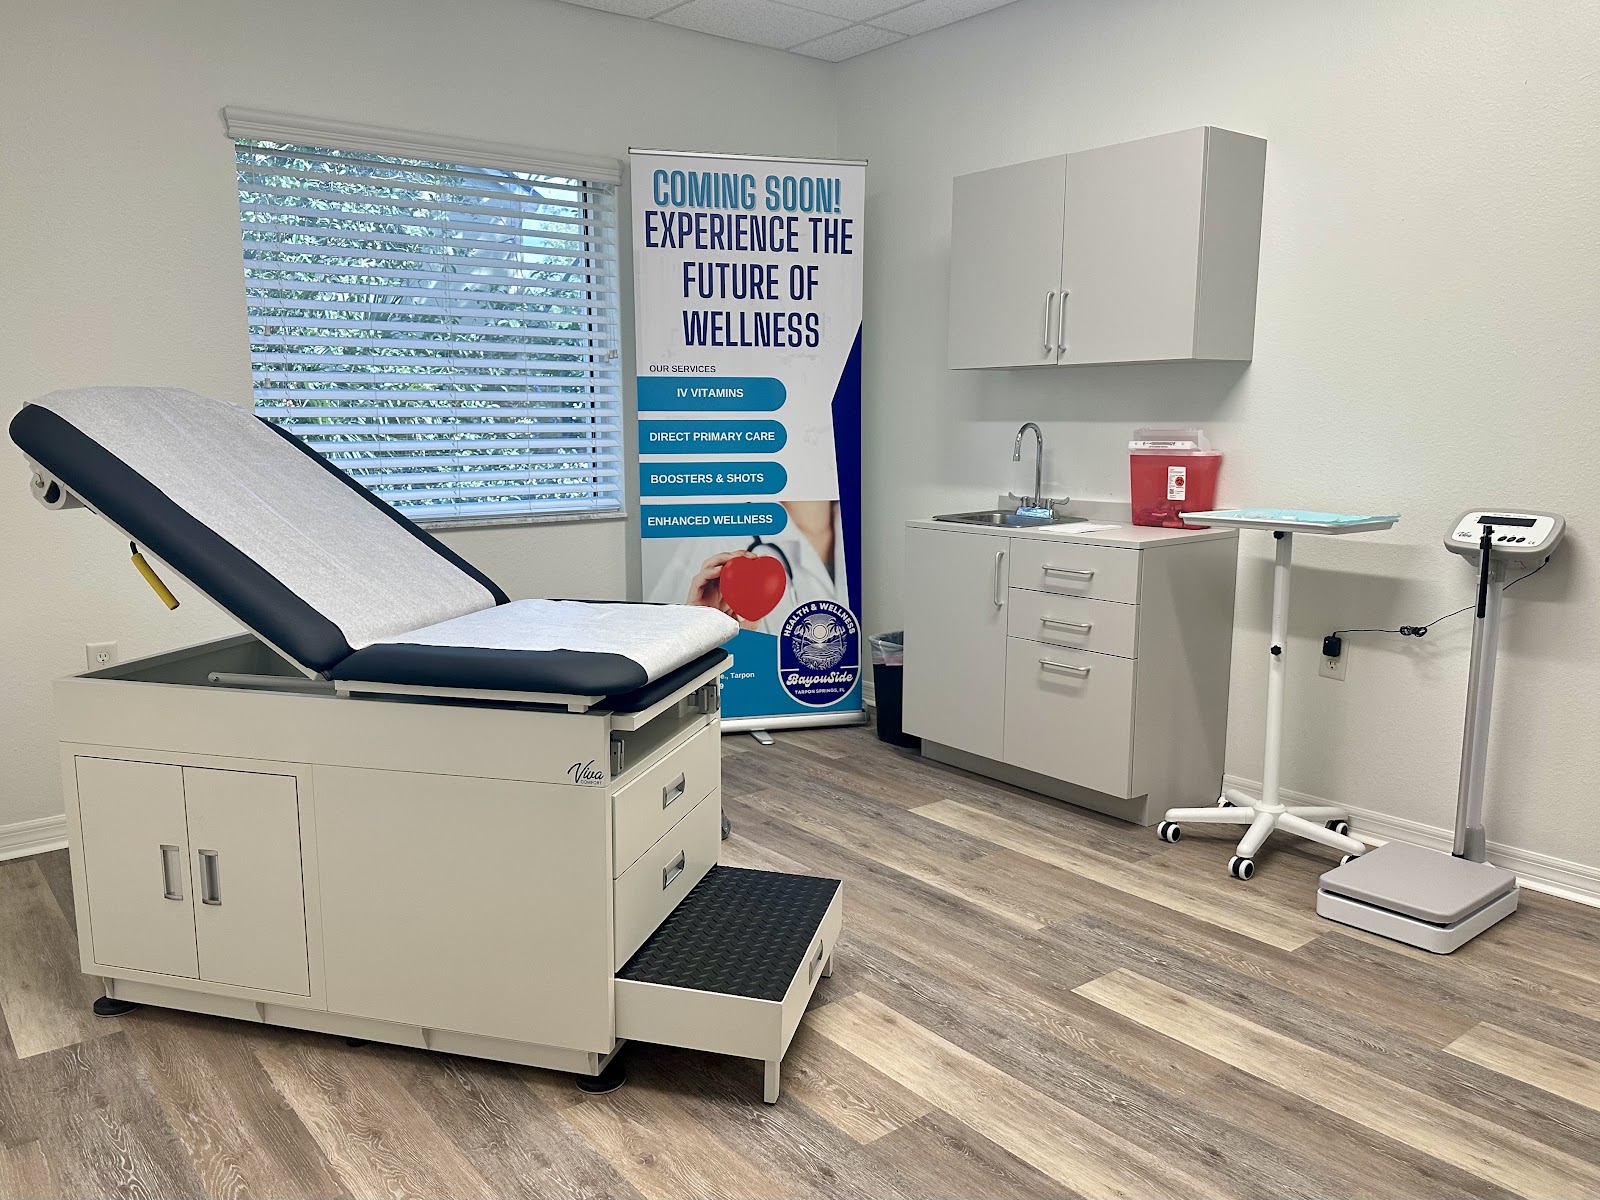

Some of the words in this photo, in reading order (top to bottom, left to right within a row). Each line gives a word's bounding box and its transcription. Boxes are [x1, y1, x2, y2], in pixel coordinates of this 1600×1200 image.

[653, 169, 756, 211] COMING
[765, 174, 842, 214] SOON!
[645, 211, 799, 253] EXPERIENCE
[808, 217, 853, 255] THE
[683, 261, 779, 300] FUTURE
[789, 264, 819, 301] OF
[682, 310, 820, 348] WELLNESS
[649, 364, 670, 373] OUR
[671, 365, 716, 373] SERVICES
[677, 388, 688, 398] IV
[690, 388, 744, 398] VITAMINS
[649, 432, 690, 442] DIRECT
[693, 432, 742, 442] PRIMARY
[745, 431, 775, 441] CARE
[650, 474, 713, 484] BOOSTERS
[715, 474, 724, 482] &
[726, 473, 764, 483] SHOTS
[647, 515, 710, 526] ENHANCED
[713, 514, 773, 524] WELLNESS
[783, 606, 809, 637] HEALTH
[810, 603, 818, 611] &
[819, 602, 856, 635] WELLNESS
[730, 672, 755, 680] Tarpon
[786, 671, 853, 687] BayouSide
[567, 759, 604, 783] Viva
